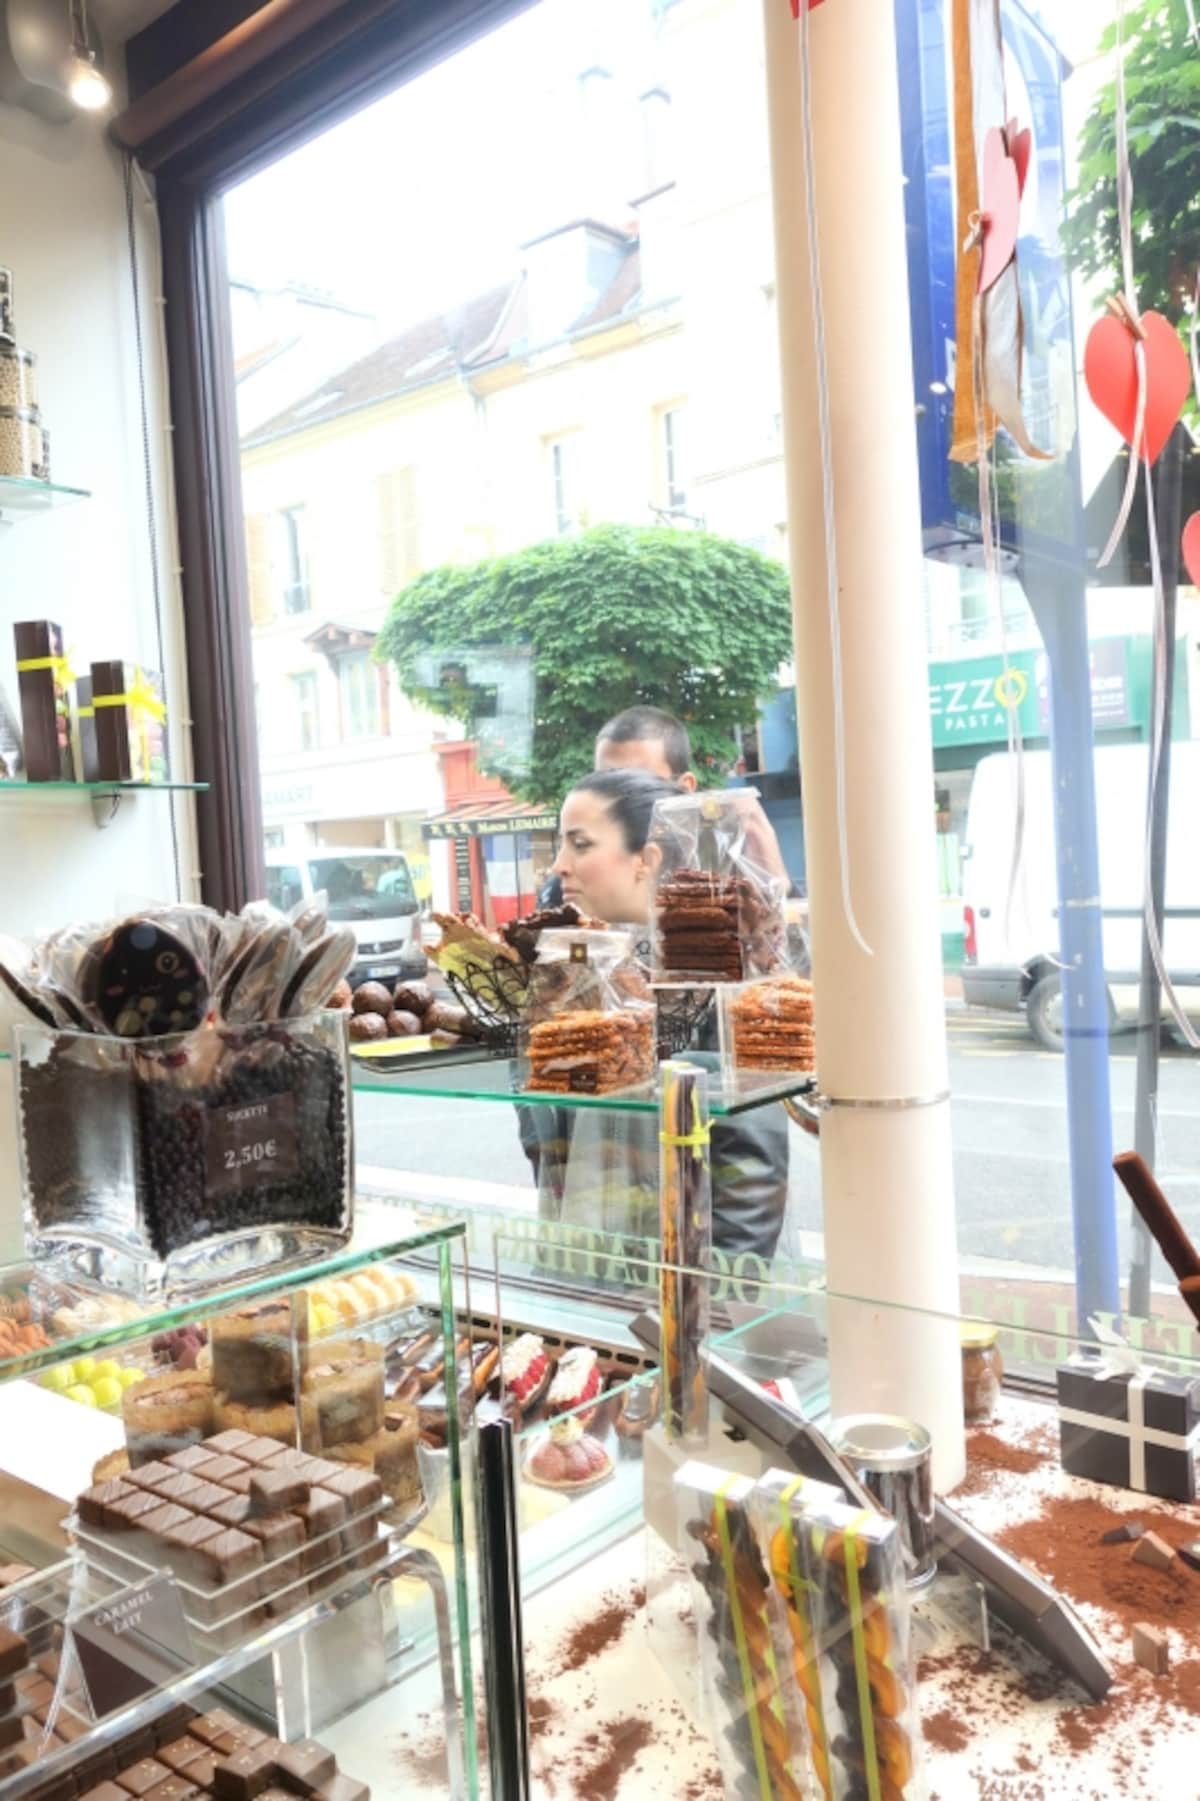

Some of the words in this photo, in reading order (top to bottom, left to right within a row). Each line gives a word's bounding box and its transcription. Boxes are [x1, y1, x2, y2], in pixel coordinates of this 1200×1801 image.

[944, 711, 1005, 731] PASTA
[224, 1138, 277, 1169] 2,50€
[94, 1590, 154, 1627] CARAMEL
